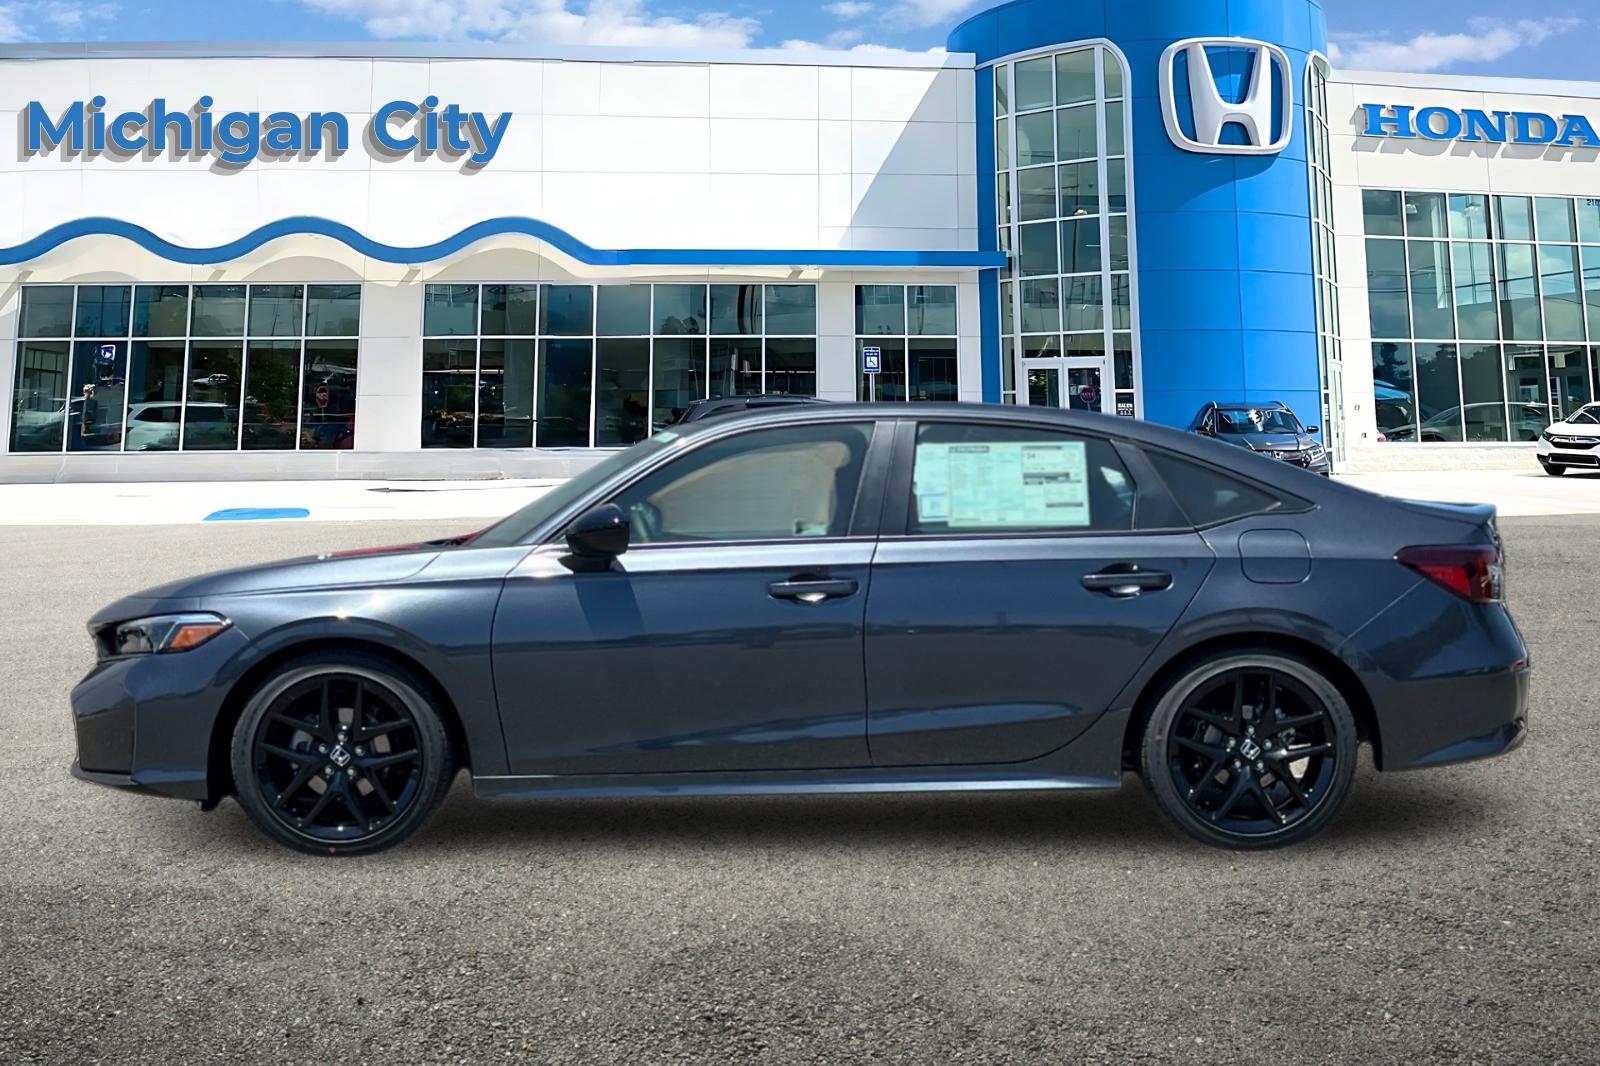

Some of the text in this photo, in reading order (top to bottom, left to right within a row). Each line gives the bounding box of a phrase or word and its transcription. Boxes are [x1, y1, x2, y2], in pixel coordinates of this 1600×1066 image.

[29, 95, 512, 163] Michigan City
[1362, 103, 1600, 147] HONDA
